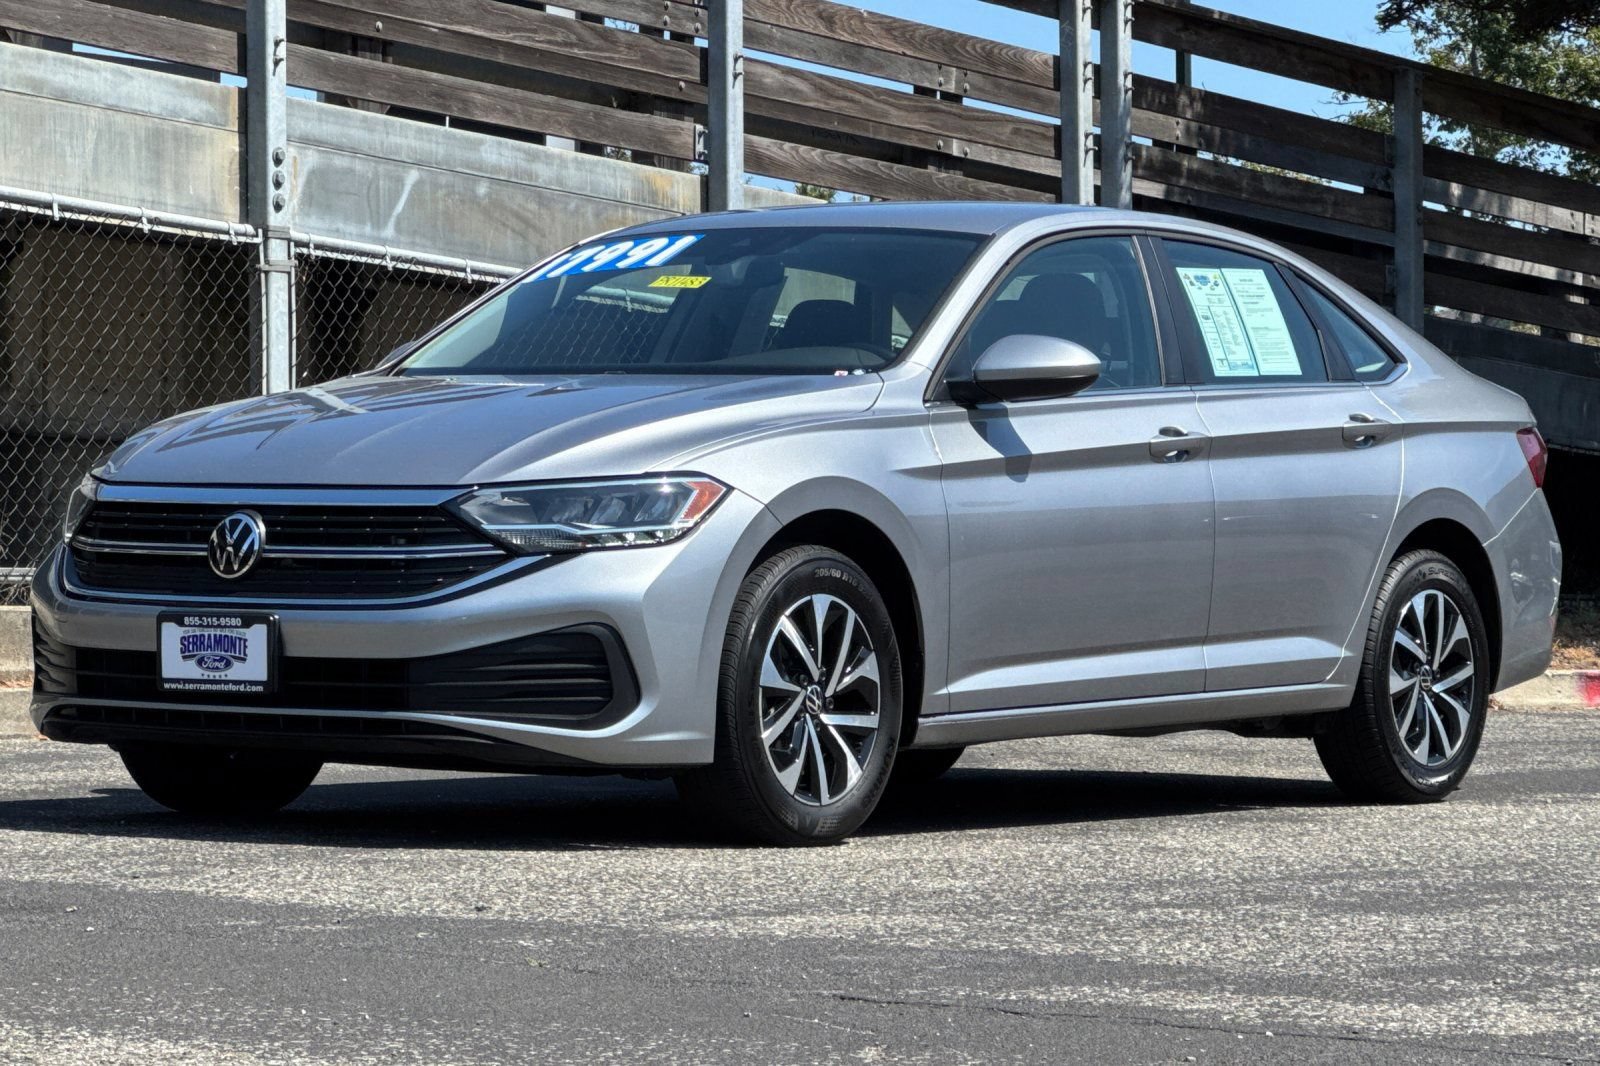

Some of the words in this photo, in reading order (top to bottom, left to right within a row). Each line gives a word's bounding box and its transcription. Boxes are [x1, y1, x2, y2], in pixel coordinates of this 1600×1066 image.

[184, 617, 242, 626] 855-315-9580
[180, 633, 248, 657] SERRAMONTE
[202, 656, 226, 669] Ford
[163, 682, 264, 692] www.serramonteford.com
